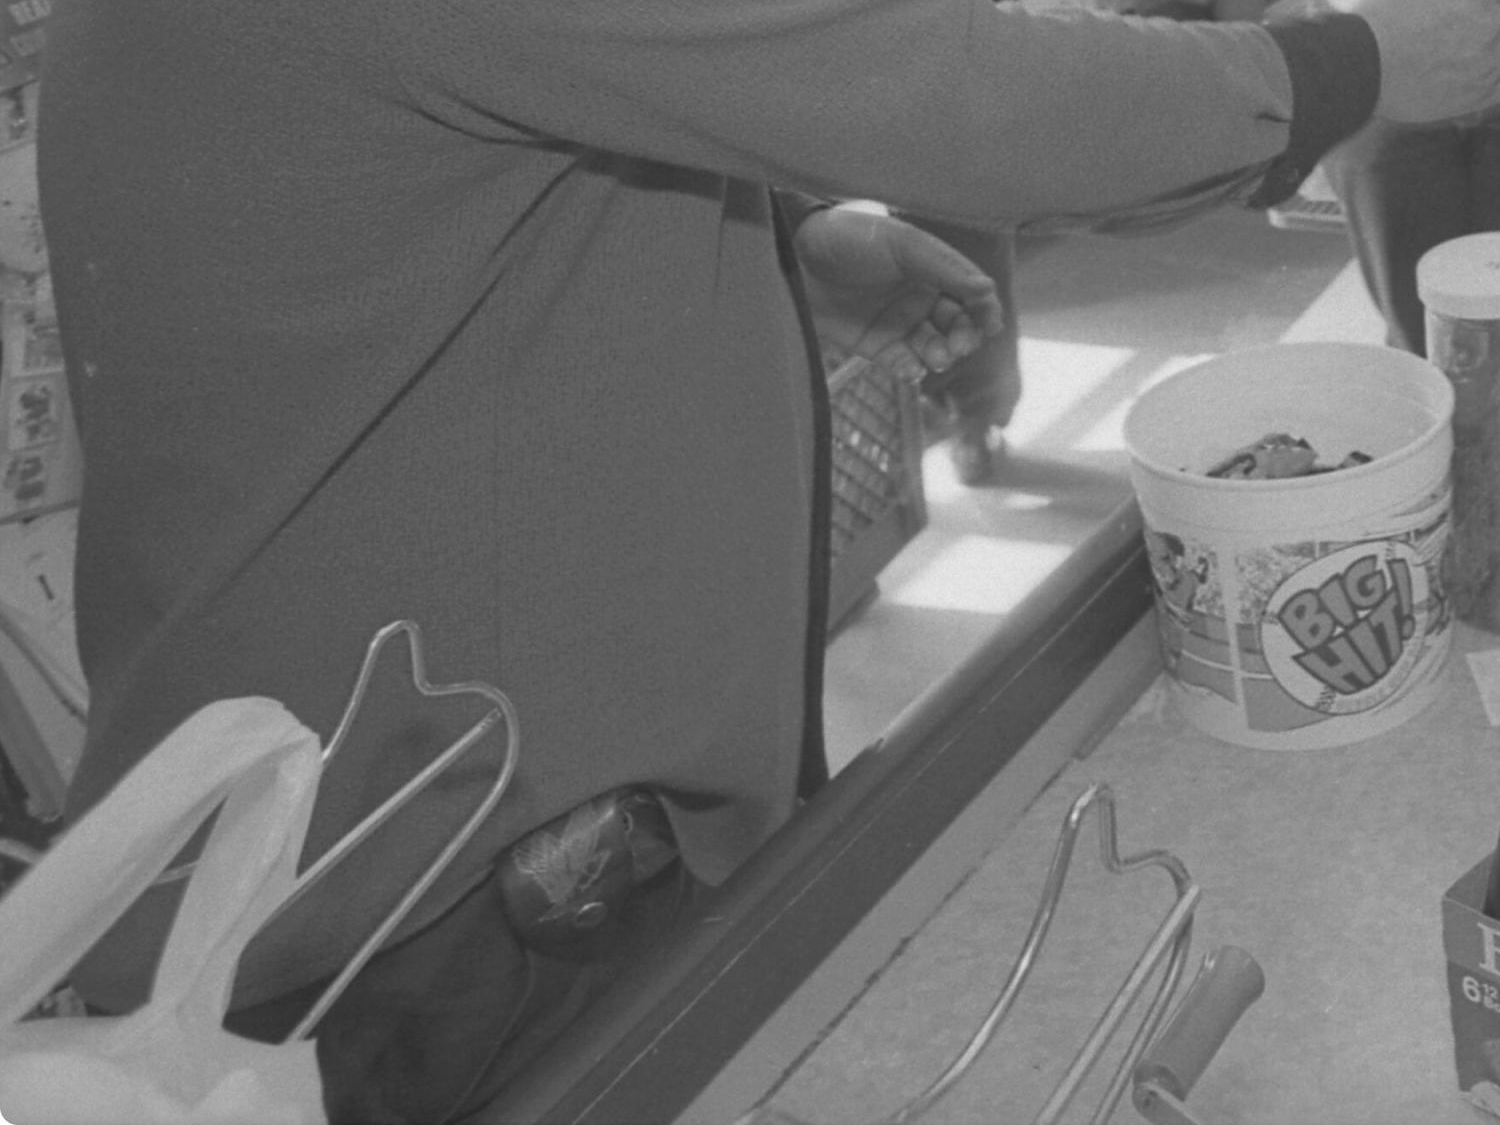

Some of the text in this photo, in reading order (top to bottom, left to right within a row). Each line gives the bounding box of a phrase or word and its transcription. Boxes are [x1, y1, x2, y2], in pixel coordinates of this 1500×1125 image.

[1278, 554, 1387, 651] BIG
[1291, 557, 1417, 696] HIT!
[1462, 975, 1481, 1004] 6
[1482, 983, 1499, 1000] 12
